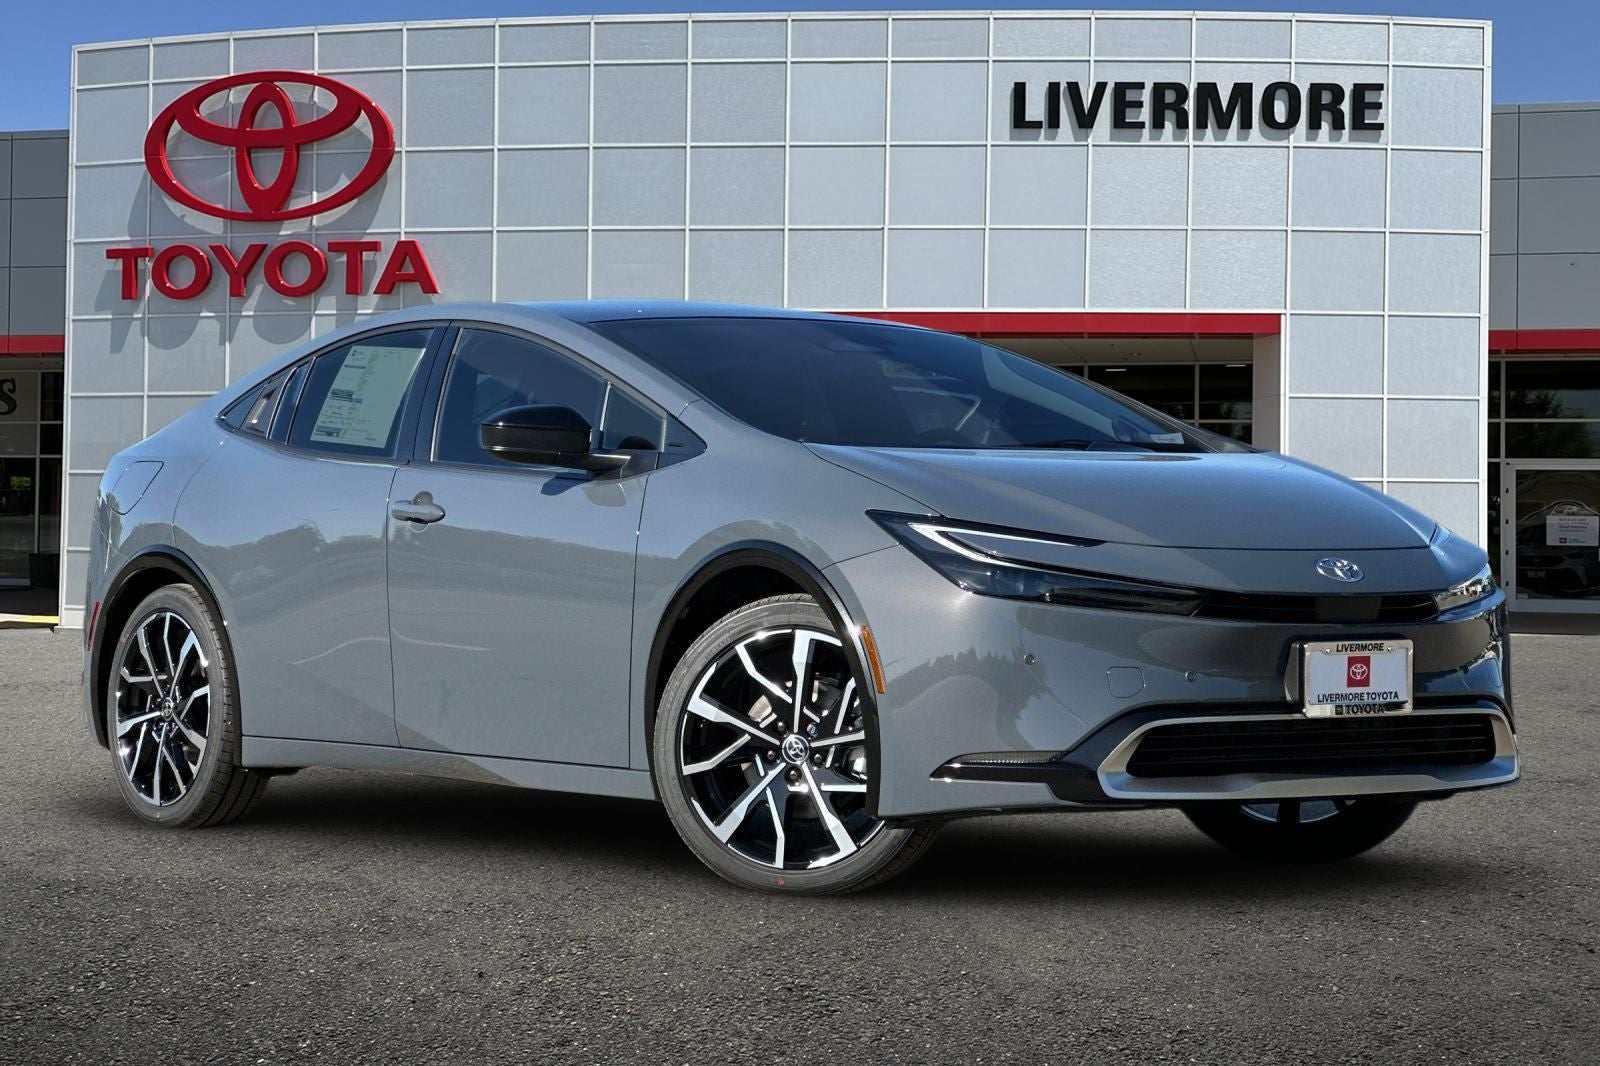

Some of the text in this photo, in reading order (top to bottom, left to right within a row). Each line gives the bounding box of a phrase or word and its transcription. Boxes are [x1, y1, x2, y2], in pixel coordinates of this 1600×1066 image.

[1012, 80, 1385, 131] LIVERMORE
[105, 239, 441, 300] TOYOTA
[1335, 642, 1385, 653] LIVERMORE
[1317, 691, 1400, 703] LIVERMORE TOYOTA
[1345, 703, 1385, 715] TOYOTA
